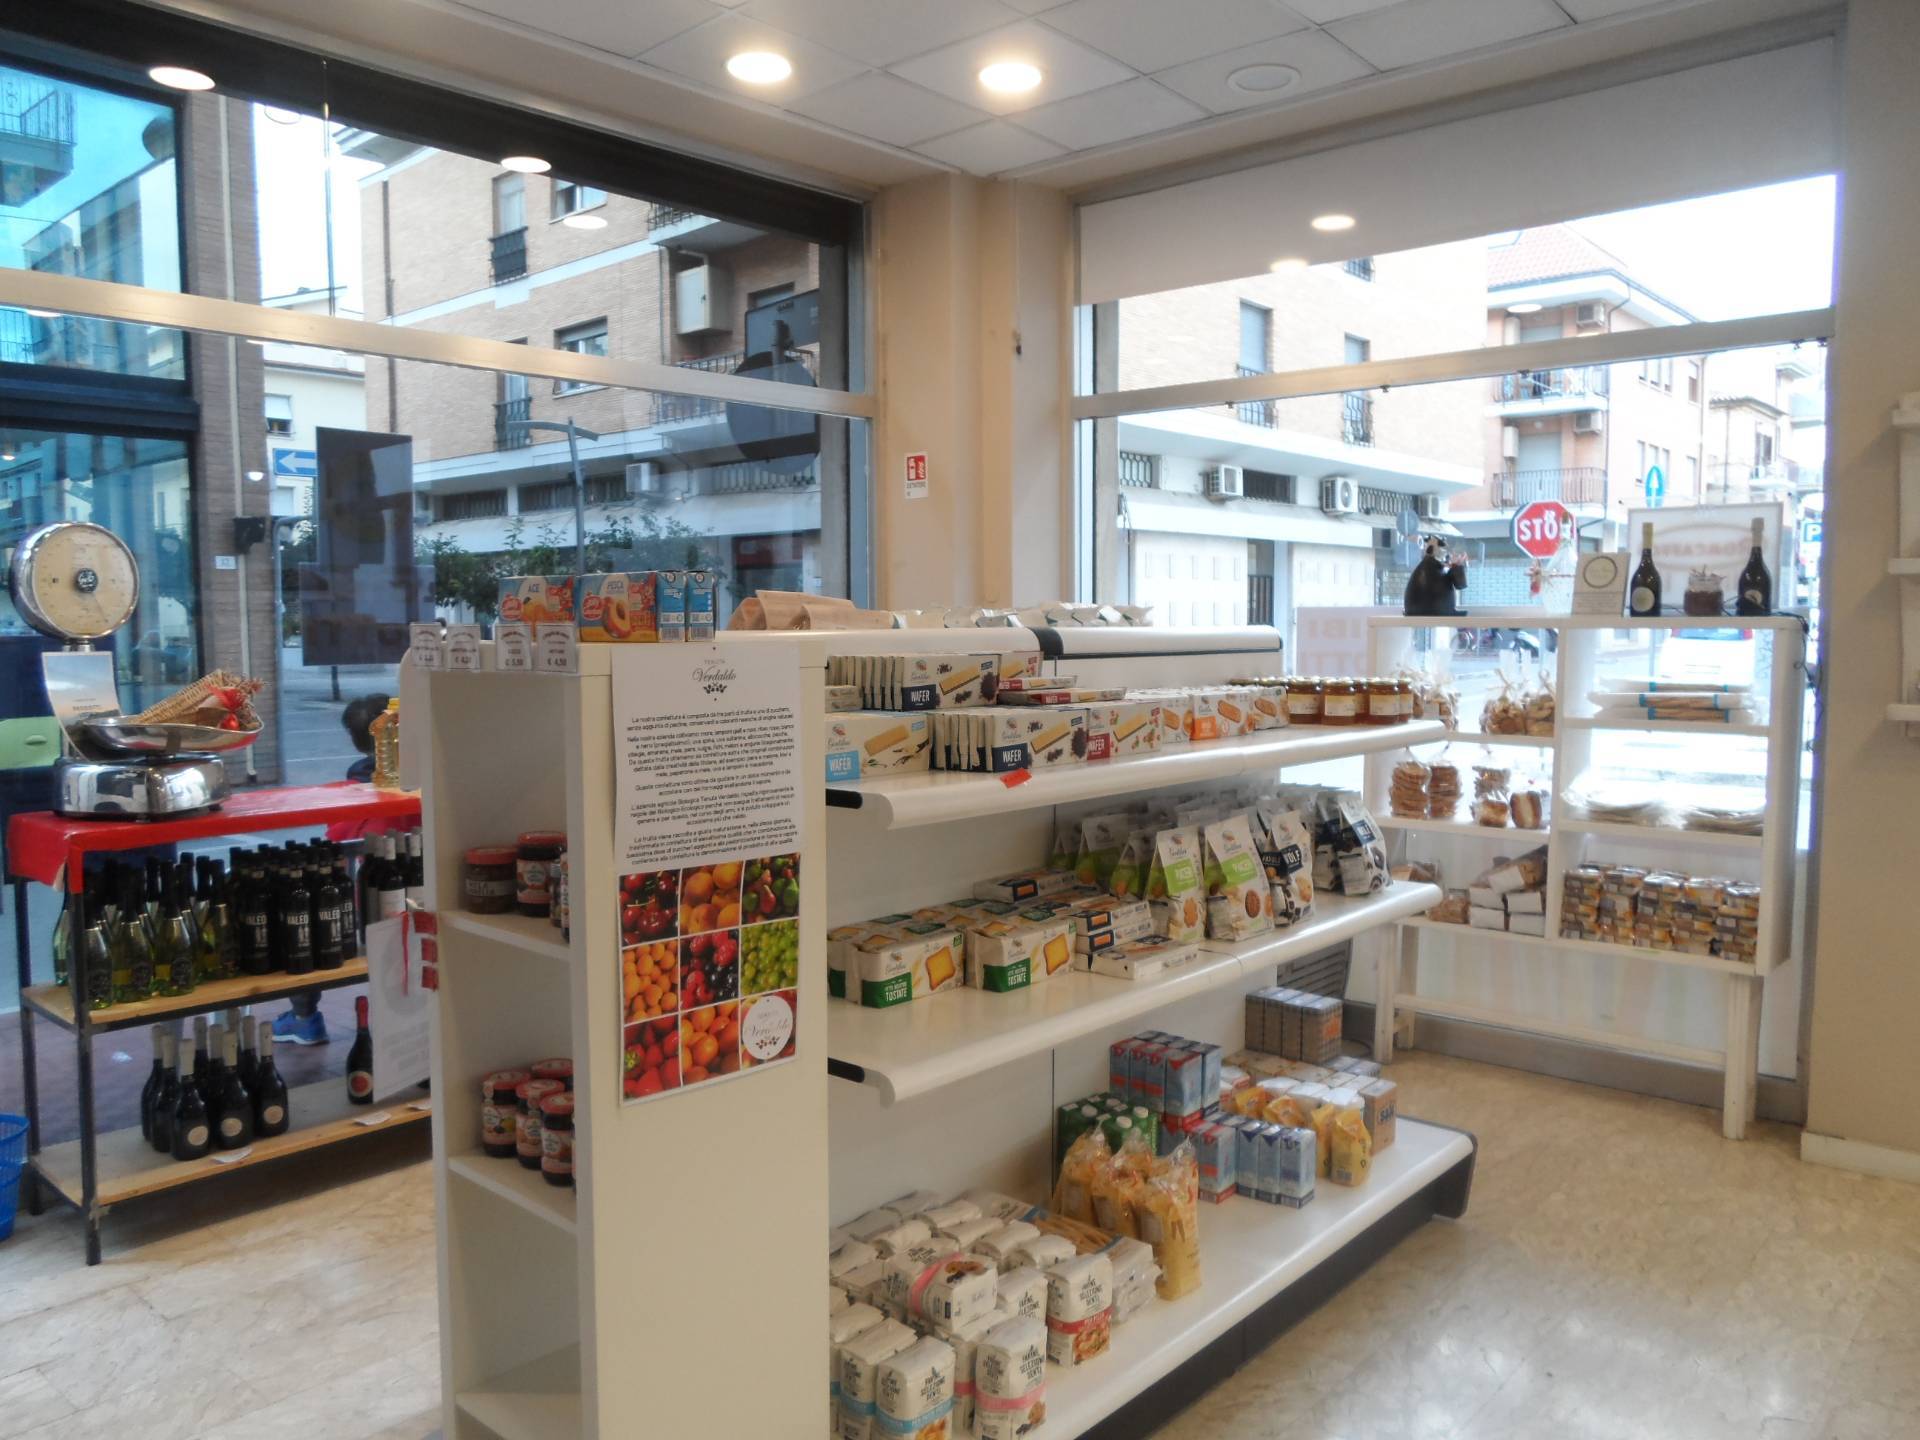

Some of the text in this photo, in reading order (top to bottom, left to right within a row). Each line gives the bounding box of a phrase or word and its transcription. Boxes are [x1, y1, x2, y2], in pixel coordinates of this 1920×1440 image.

[1806, 524, 1822, 541] P
[692, 665, 737, 682] Verdaldo
[911, 690, 930, 703] WAFER
[1002, 749, 1022, 762] WAFER
[830, 757, 852, 771] WAFER
[1007, 973, 1027, 987] TOSTATE
[885, 987, 908, 1002] TOSTATE
